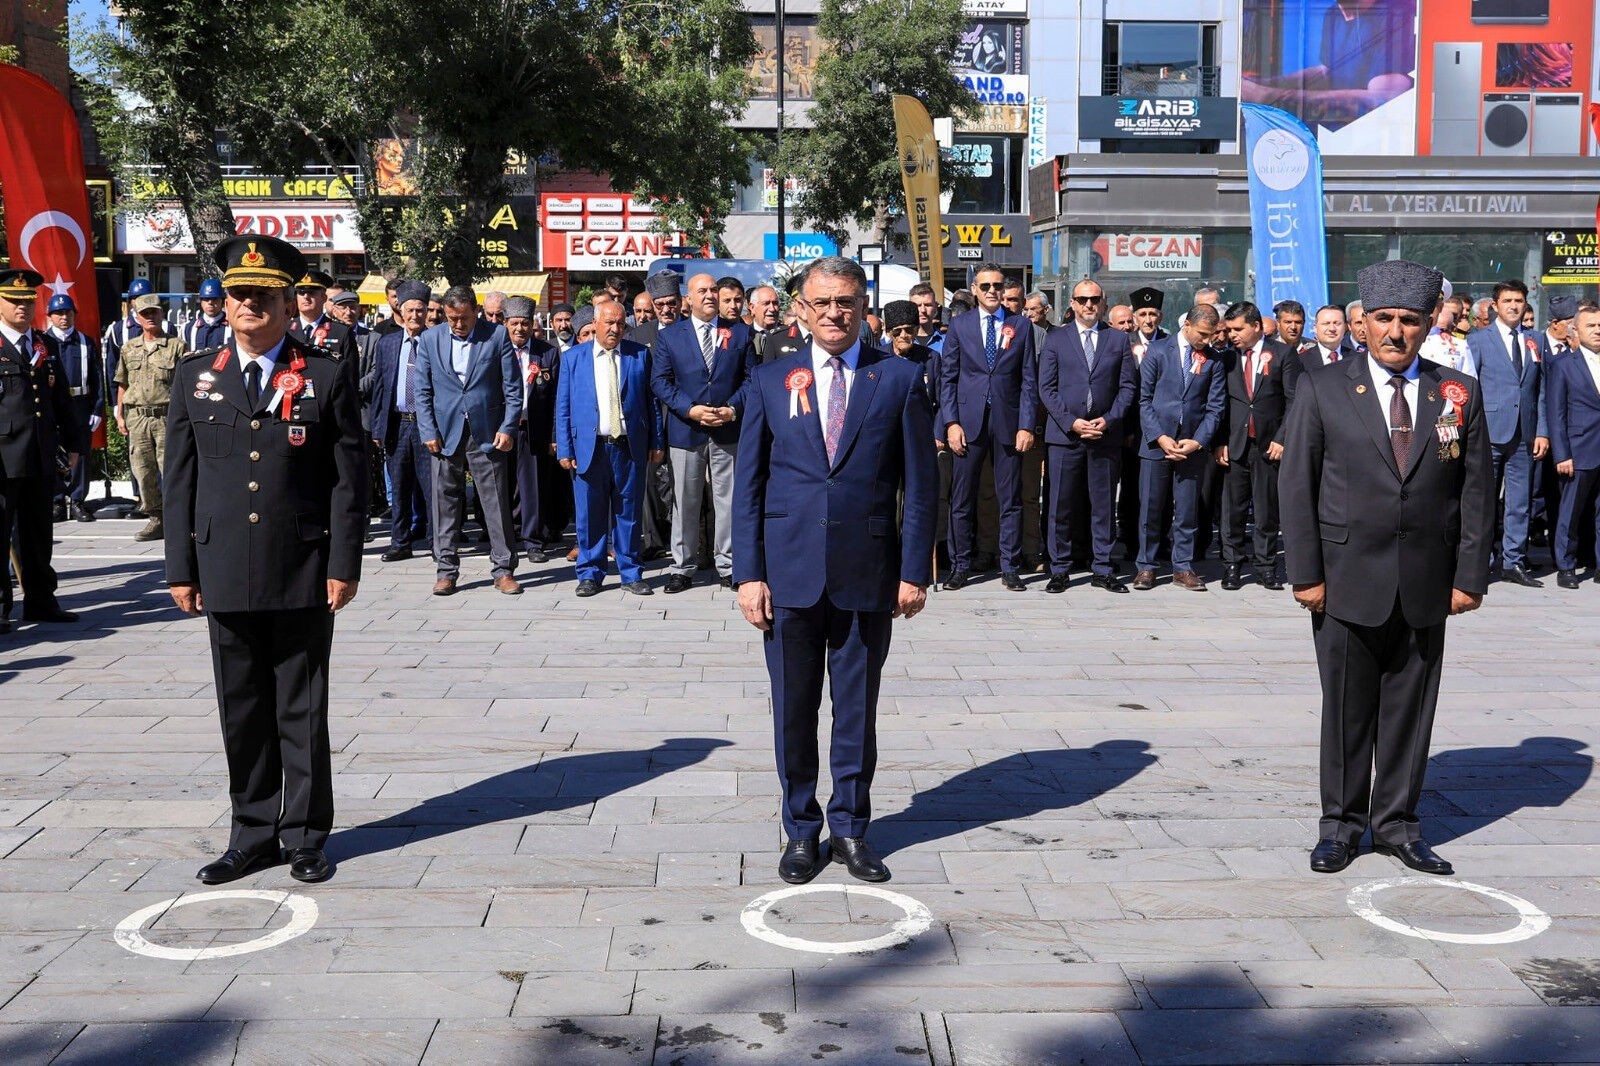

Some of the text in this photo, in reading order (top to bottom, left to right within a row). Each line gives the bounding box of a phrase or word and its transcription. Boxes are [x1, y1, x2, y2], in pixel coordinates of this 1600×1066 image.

[1114, 117, 1201, 128] BİLGİSAYAR
[222, 180, 327, 196] HENK CAFE
[1486, 194, 1527, 212] AVM
[235, 215, 339, 240] ZDEN
[959, 249, 979, 257] MEN
[1555, 244, 1592, 256] KİTAP
[600, 258, 646, 268] SERHAT
[1143, 258, 1188, 269] GÜLSEVEN
